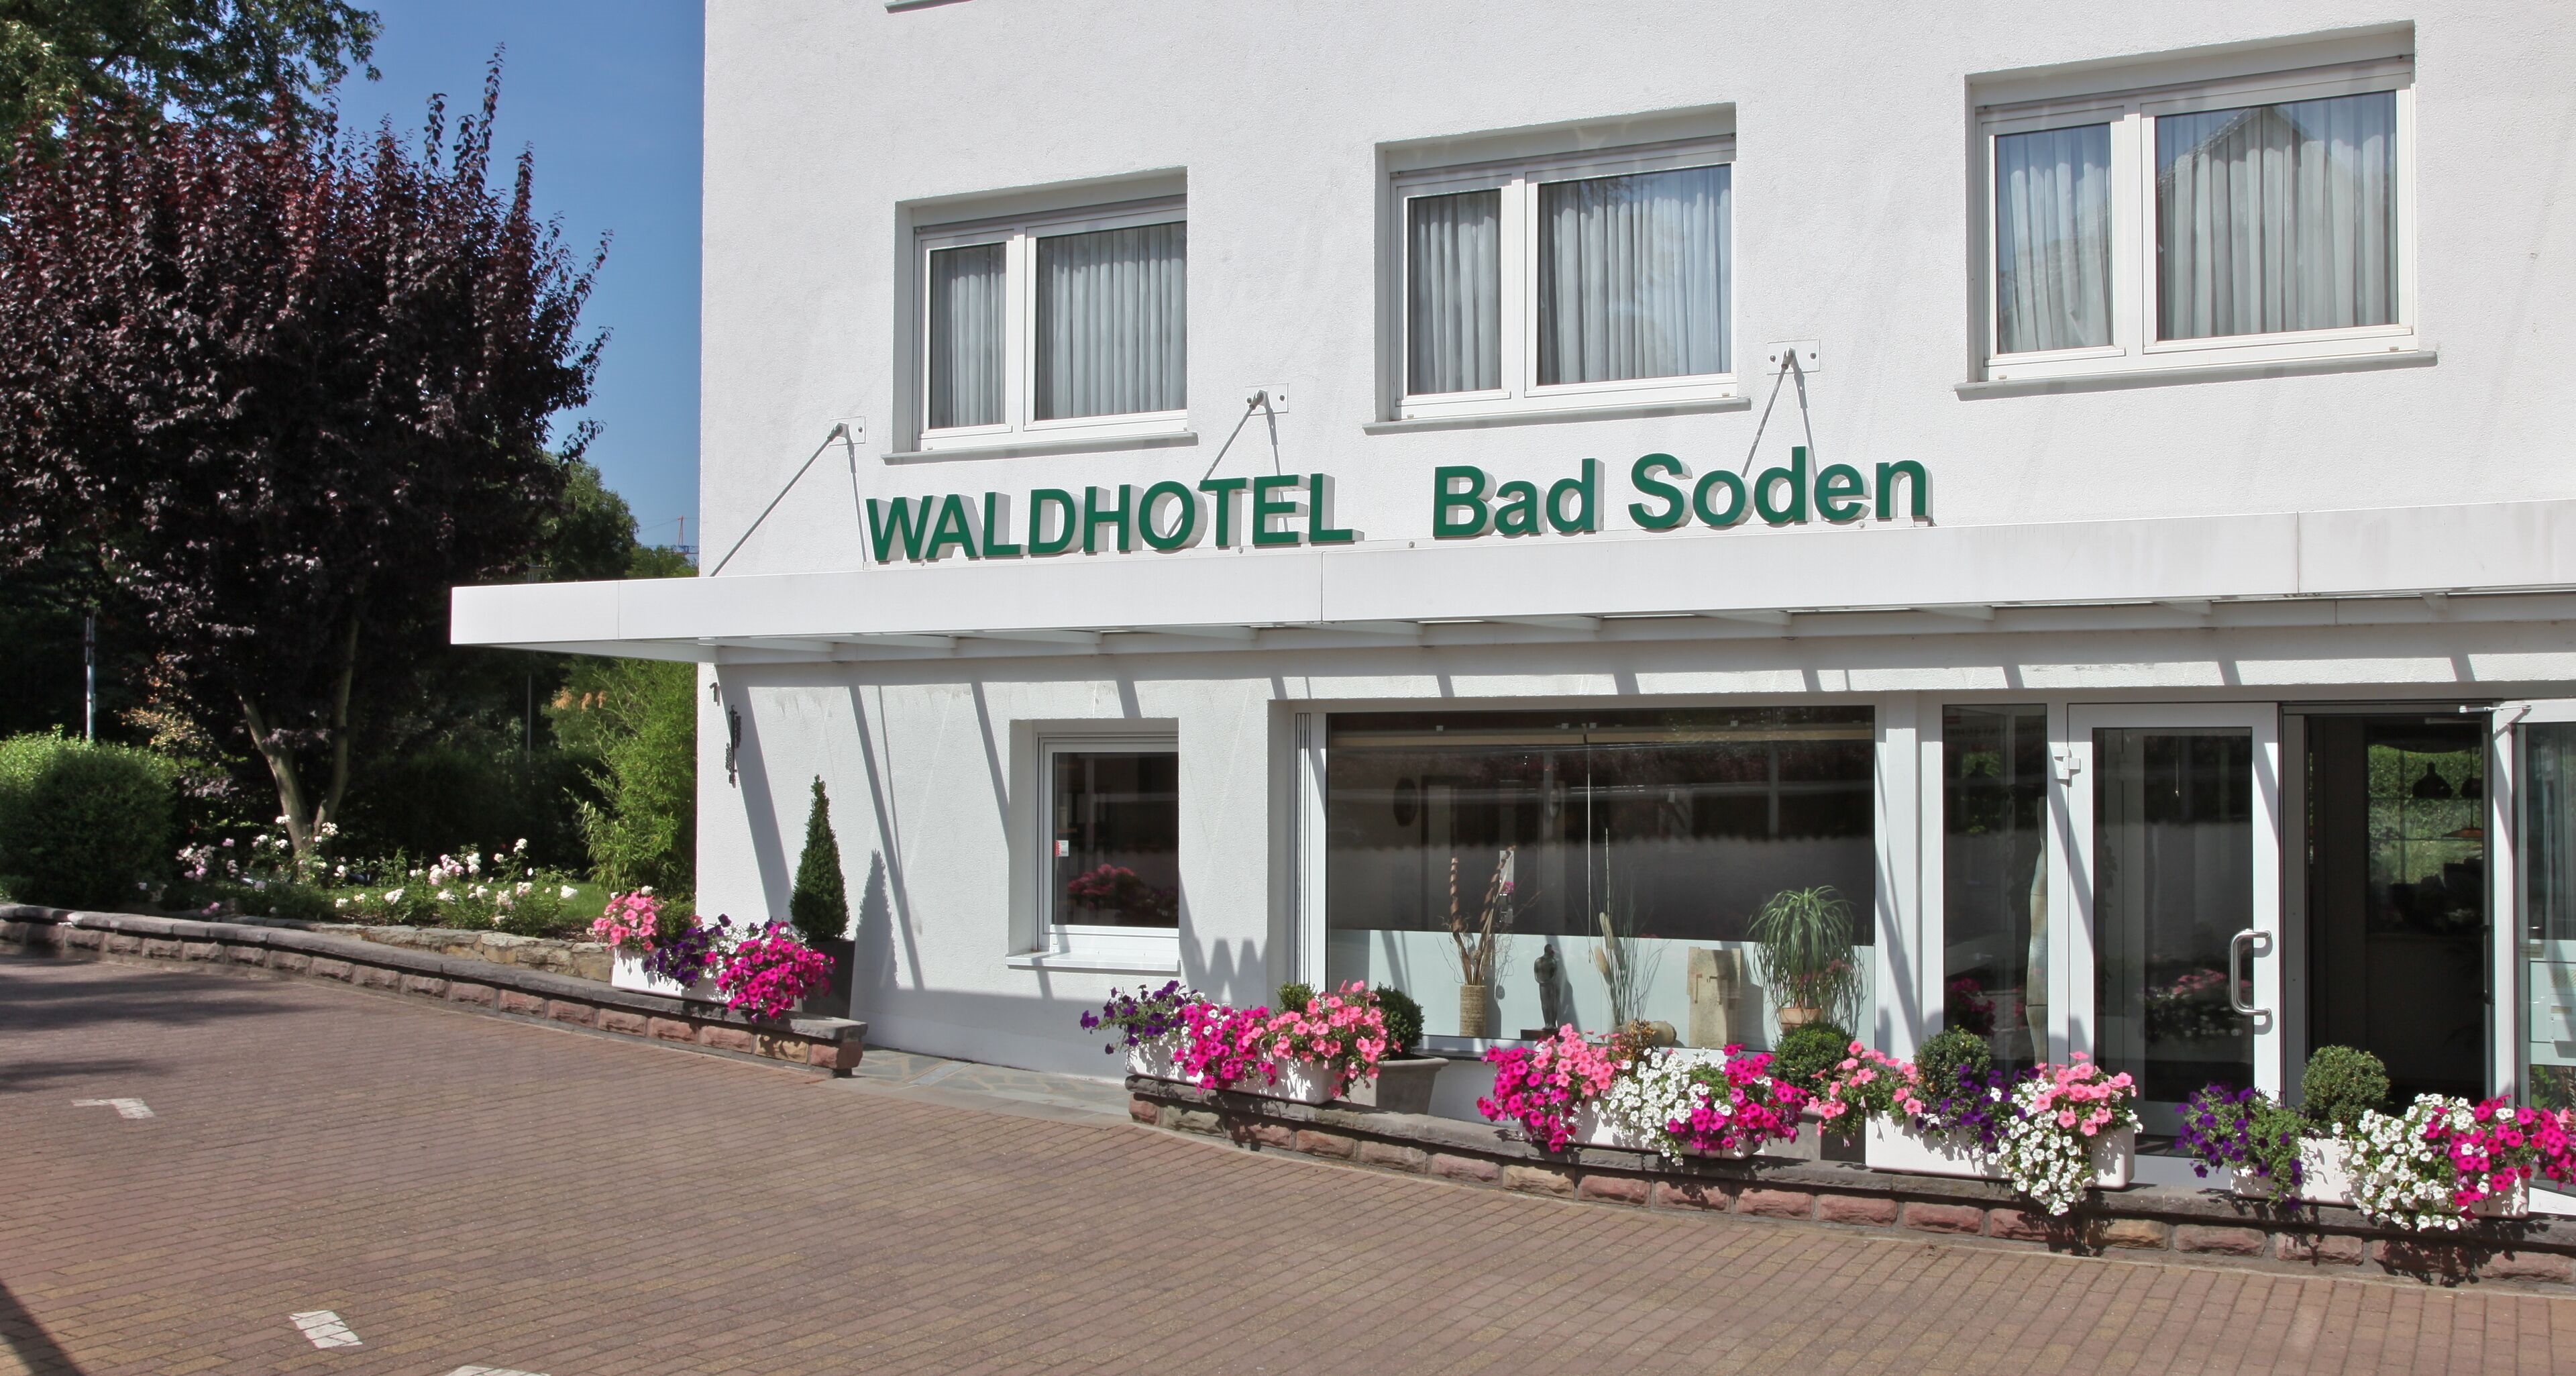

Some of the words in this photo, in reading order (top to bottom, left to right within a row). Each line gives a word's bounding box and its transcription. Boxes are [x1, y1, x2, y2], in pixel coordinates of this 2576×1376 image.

[866, 474, 1354, 561] WALDHOTEL
[1433, 458, 1596, 537] Bad
[1628, 446, 1927, 529] Soden
